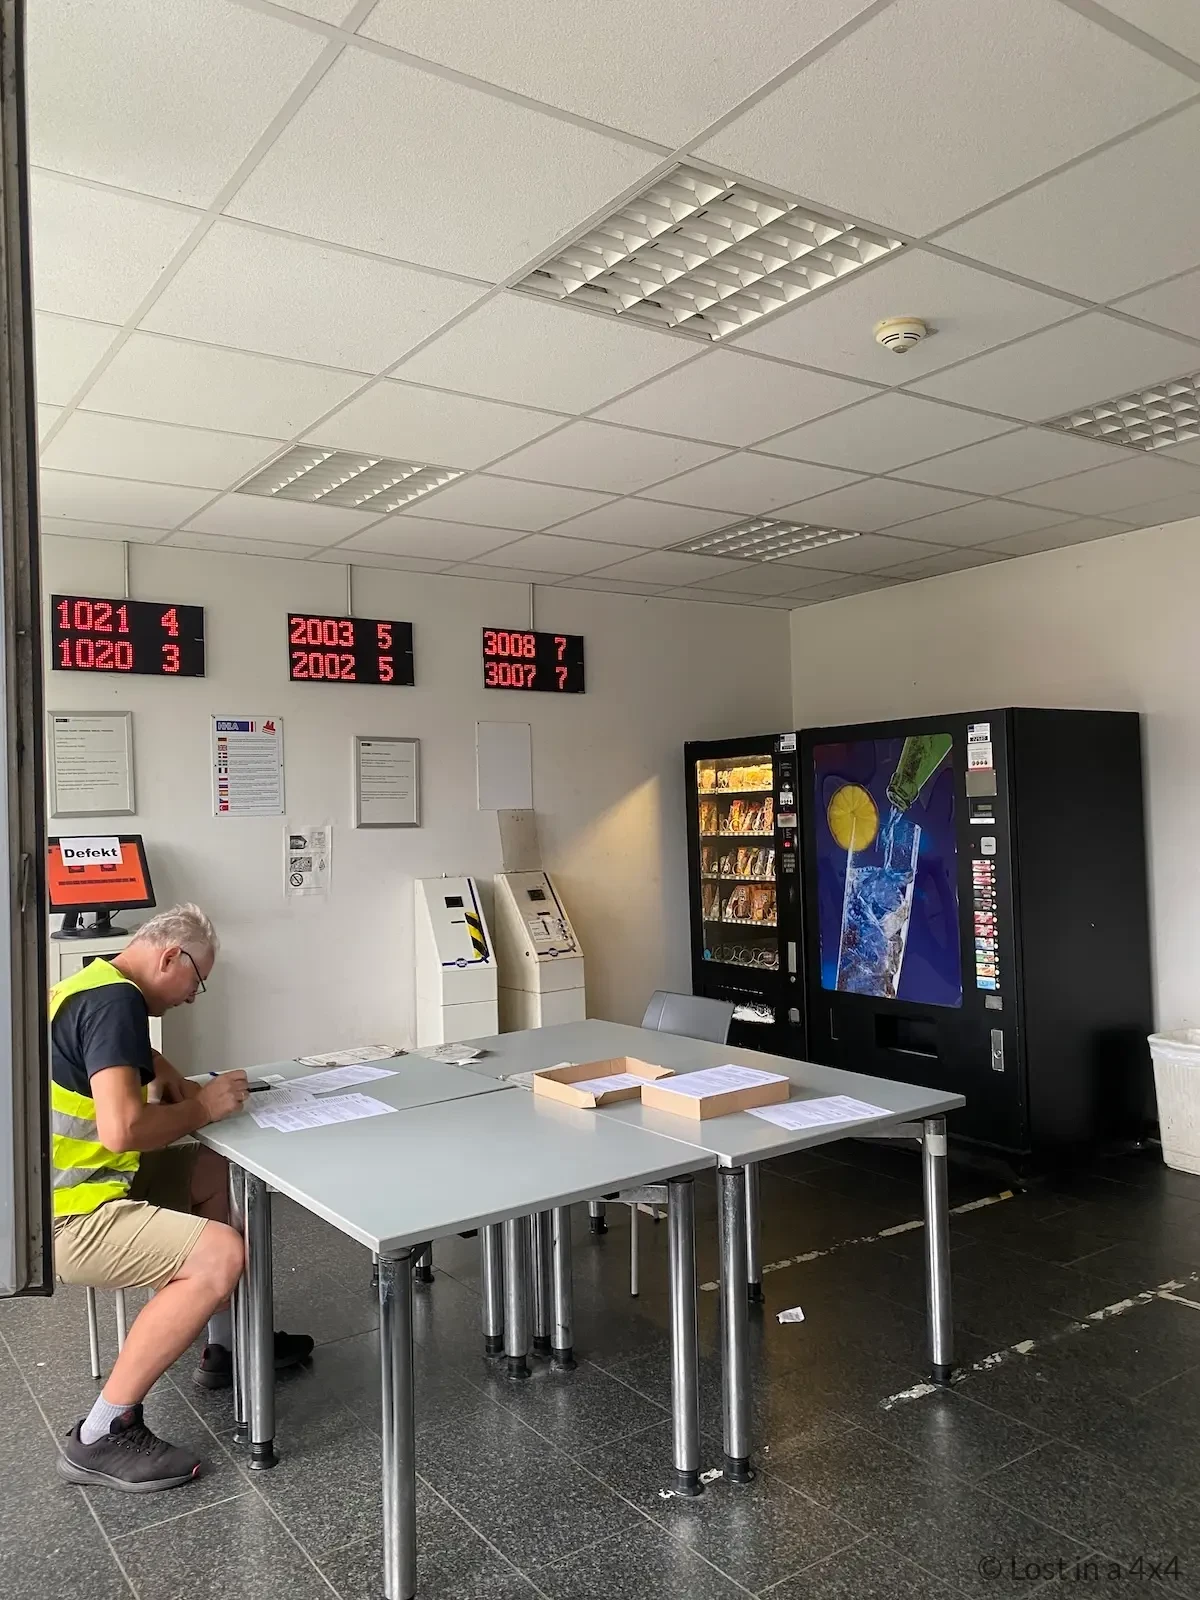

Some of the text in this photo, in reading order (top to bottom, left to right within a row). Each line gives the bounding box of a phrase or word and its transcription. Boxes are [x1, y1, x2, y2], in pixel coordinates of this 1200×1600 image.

[57, 600, 179, 636] 1021 4
[290, 618, 392, 649] 2003 5
[484, 632, 566, 660] 3008 7
[59, 638, 179, 672] 1020 3
[292, 652, 394, 681] 2002 5
[486, 662, 567, 689] 3007 7
[64, 848, 118, 858] Defekt
